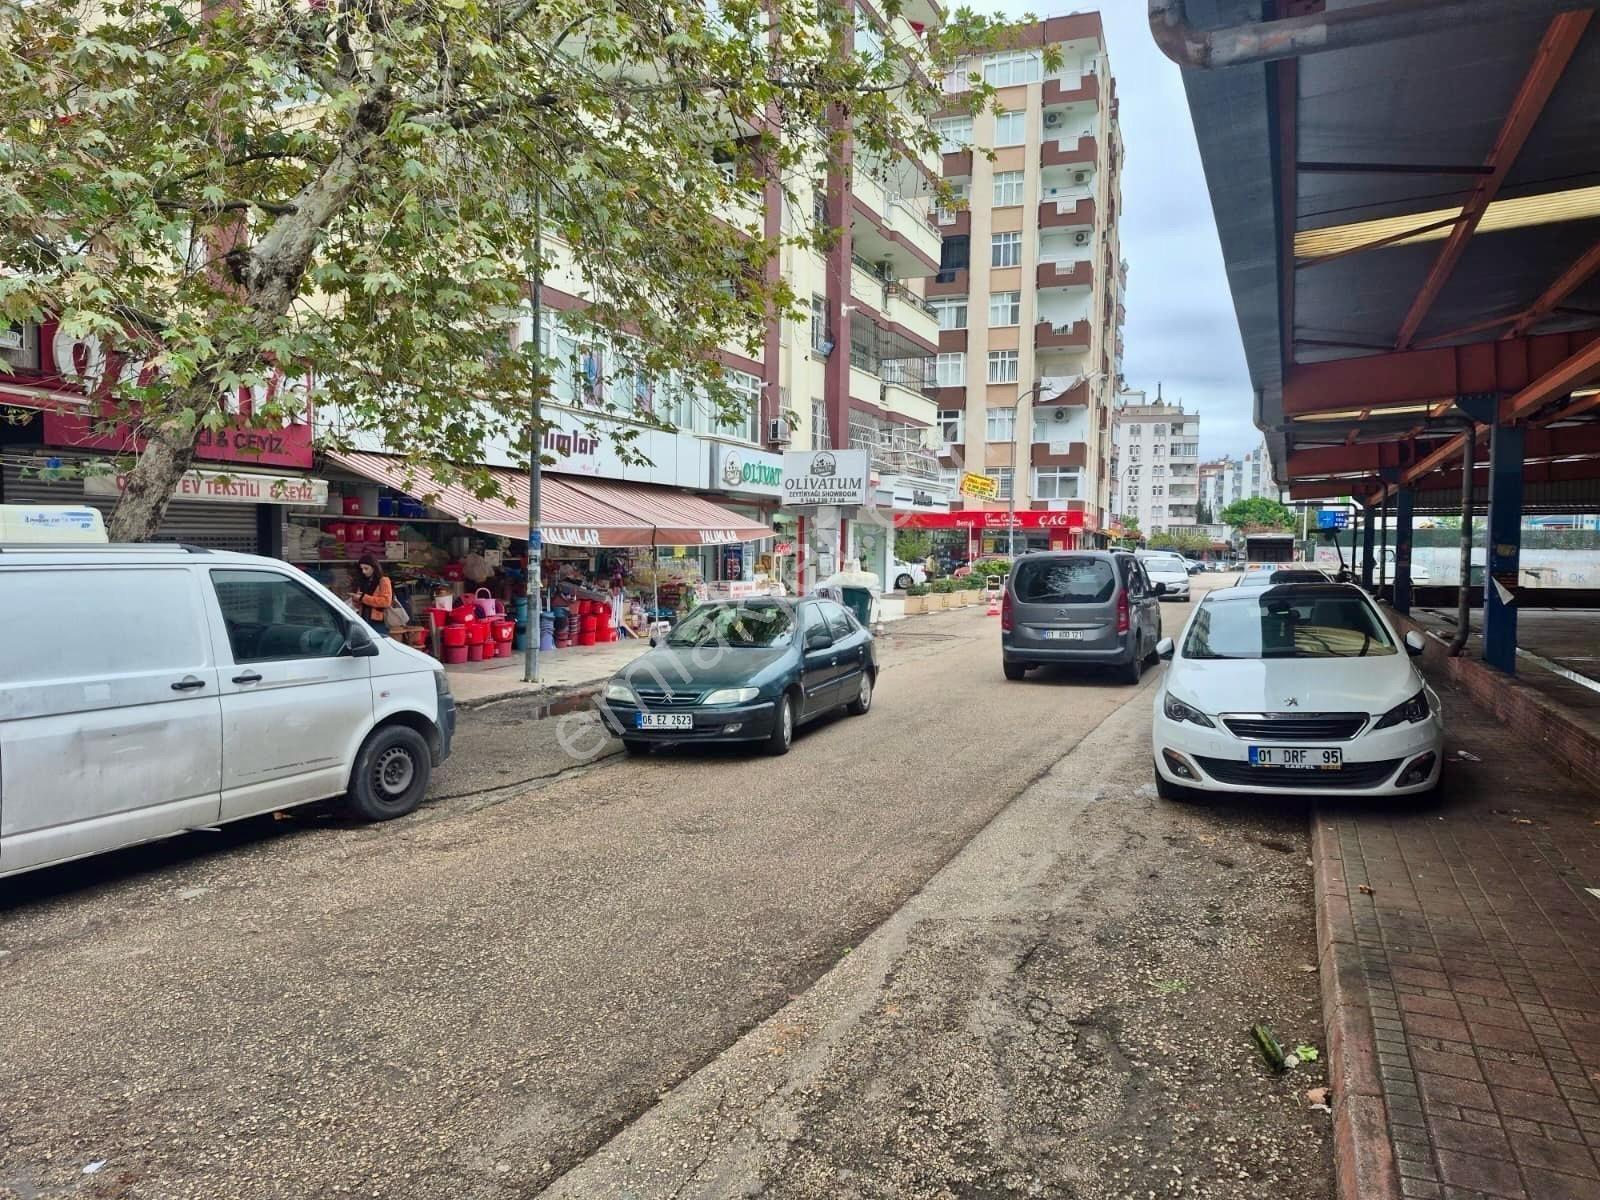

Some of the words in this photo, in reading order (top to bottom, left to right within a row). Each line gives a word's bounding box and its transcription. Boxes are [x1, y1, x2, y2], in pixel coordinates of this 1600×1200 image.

[182, 480, 200, 494] EV
[785, 475, 862, 490] OLİVATUM
[822, 490, 857, 498] SHOWROOM
[541, 528, 600, 546] YALIMLAR
[1259, 750, 1272, 762] 01
[1322, 751, 1339, 763] 95
